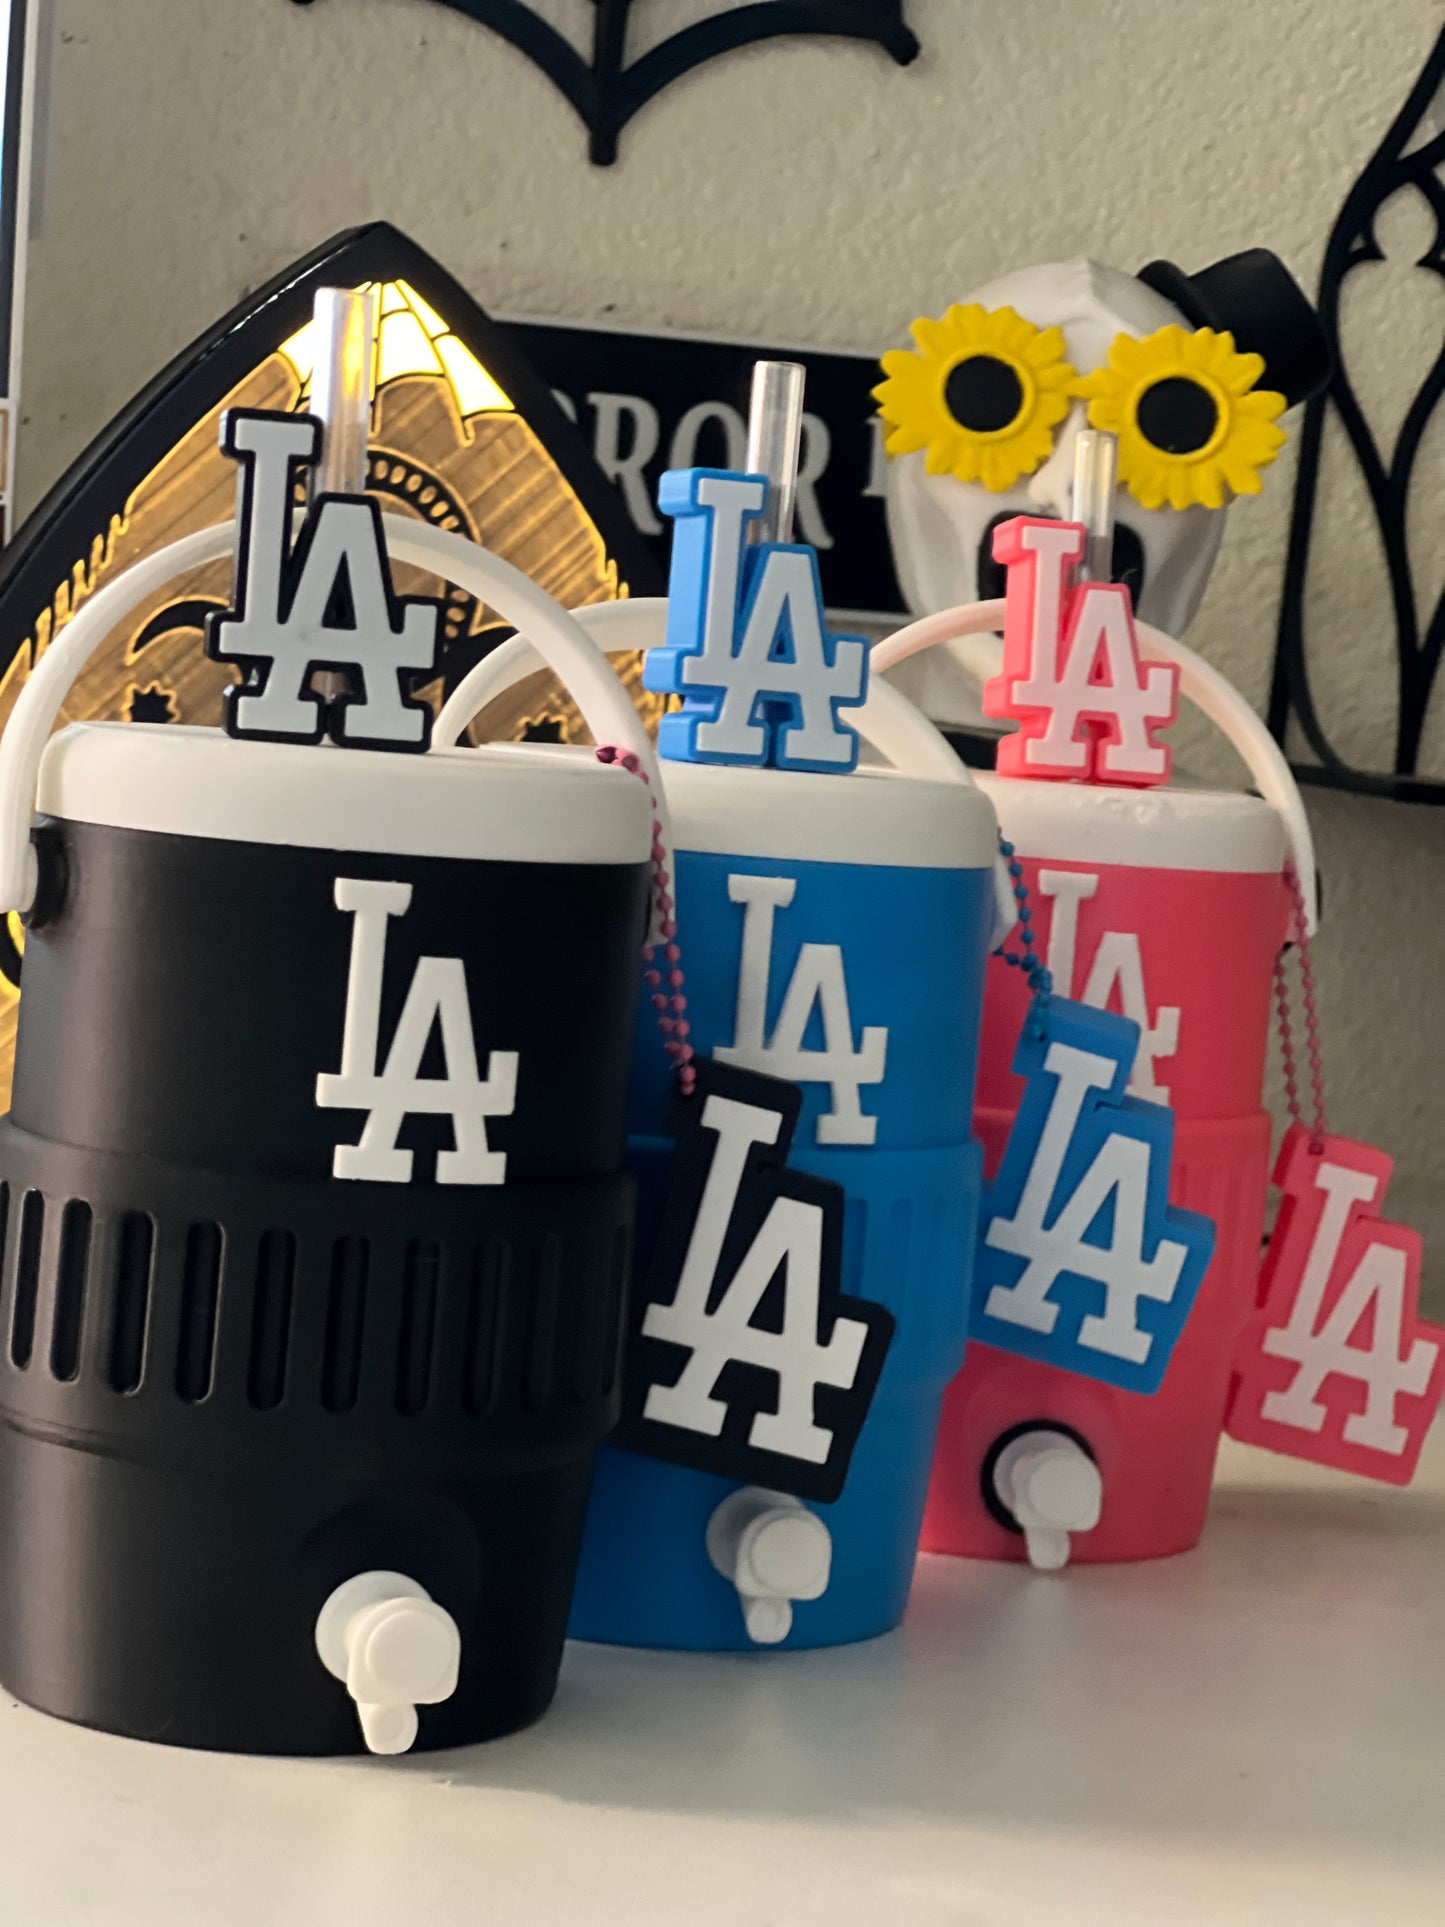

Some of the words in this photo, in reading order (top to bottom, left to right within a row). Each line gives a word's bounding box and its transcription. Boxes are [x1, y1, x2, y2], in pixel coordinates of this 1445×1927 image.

[219, 418, 437, 742] LA
[683, 479, 865, 763] LA
[1012, 526, 1174, 773] LA
[316, 877, 519, 1184] LA
[714, 874, 888, 1145] LA
[641, 1094, 868, 1464] LA
[985, 1042, 1188, 1364] LA
[1261, 1162, 1440, 1455] LA
